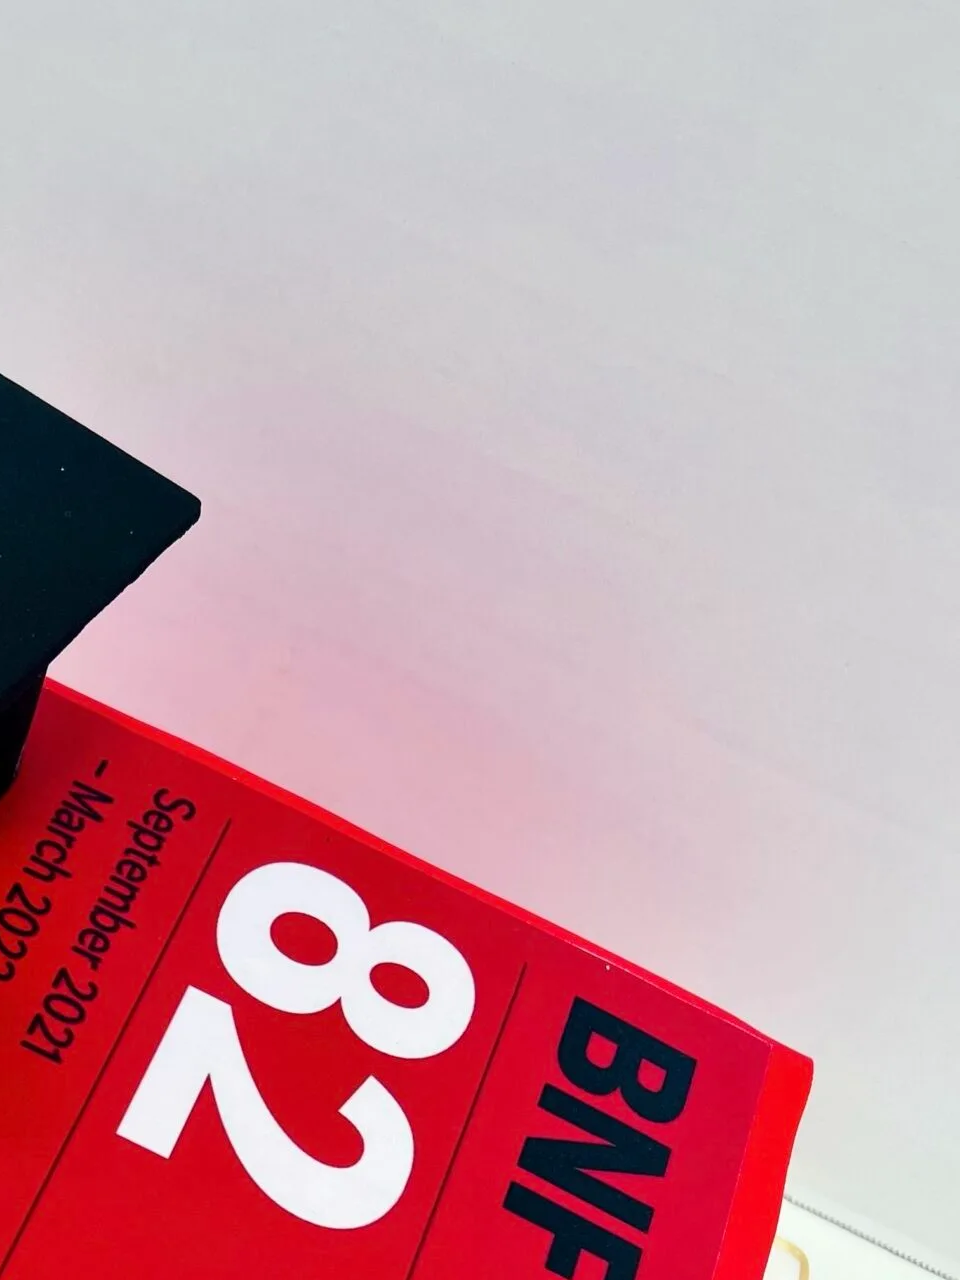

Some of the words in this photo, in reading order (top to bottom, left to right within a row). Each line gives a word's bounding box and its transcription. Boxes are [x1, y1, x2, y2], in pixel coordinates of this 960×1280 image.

[22, 780, 115, 883] March
[71, 788, 196, 972] September
[19, 966, 99, 1065] 2021
[115, 861, 476, 1230] 82
